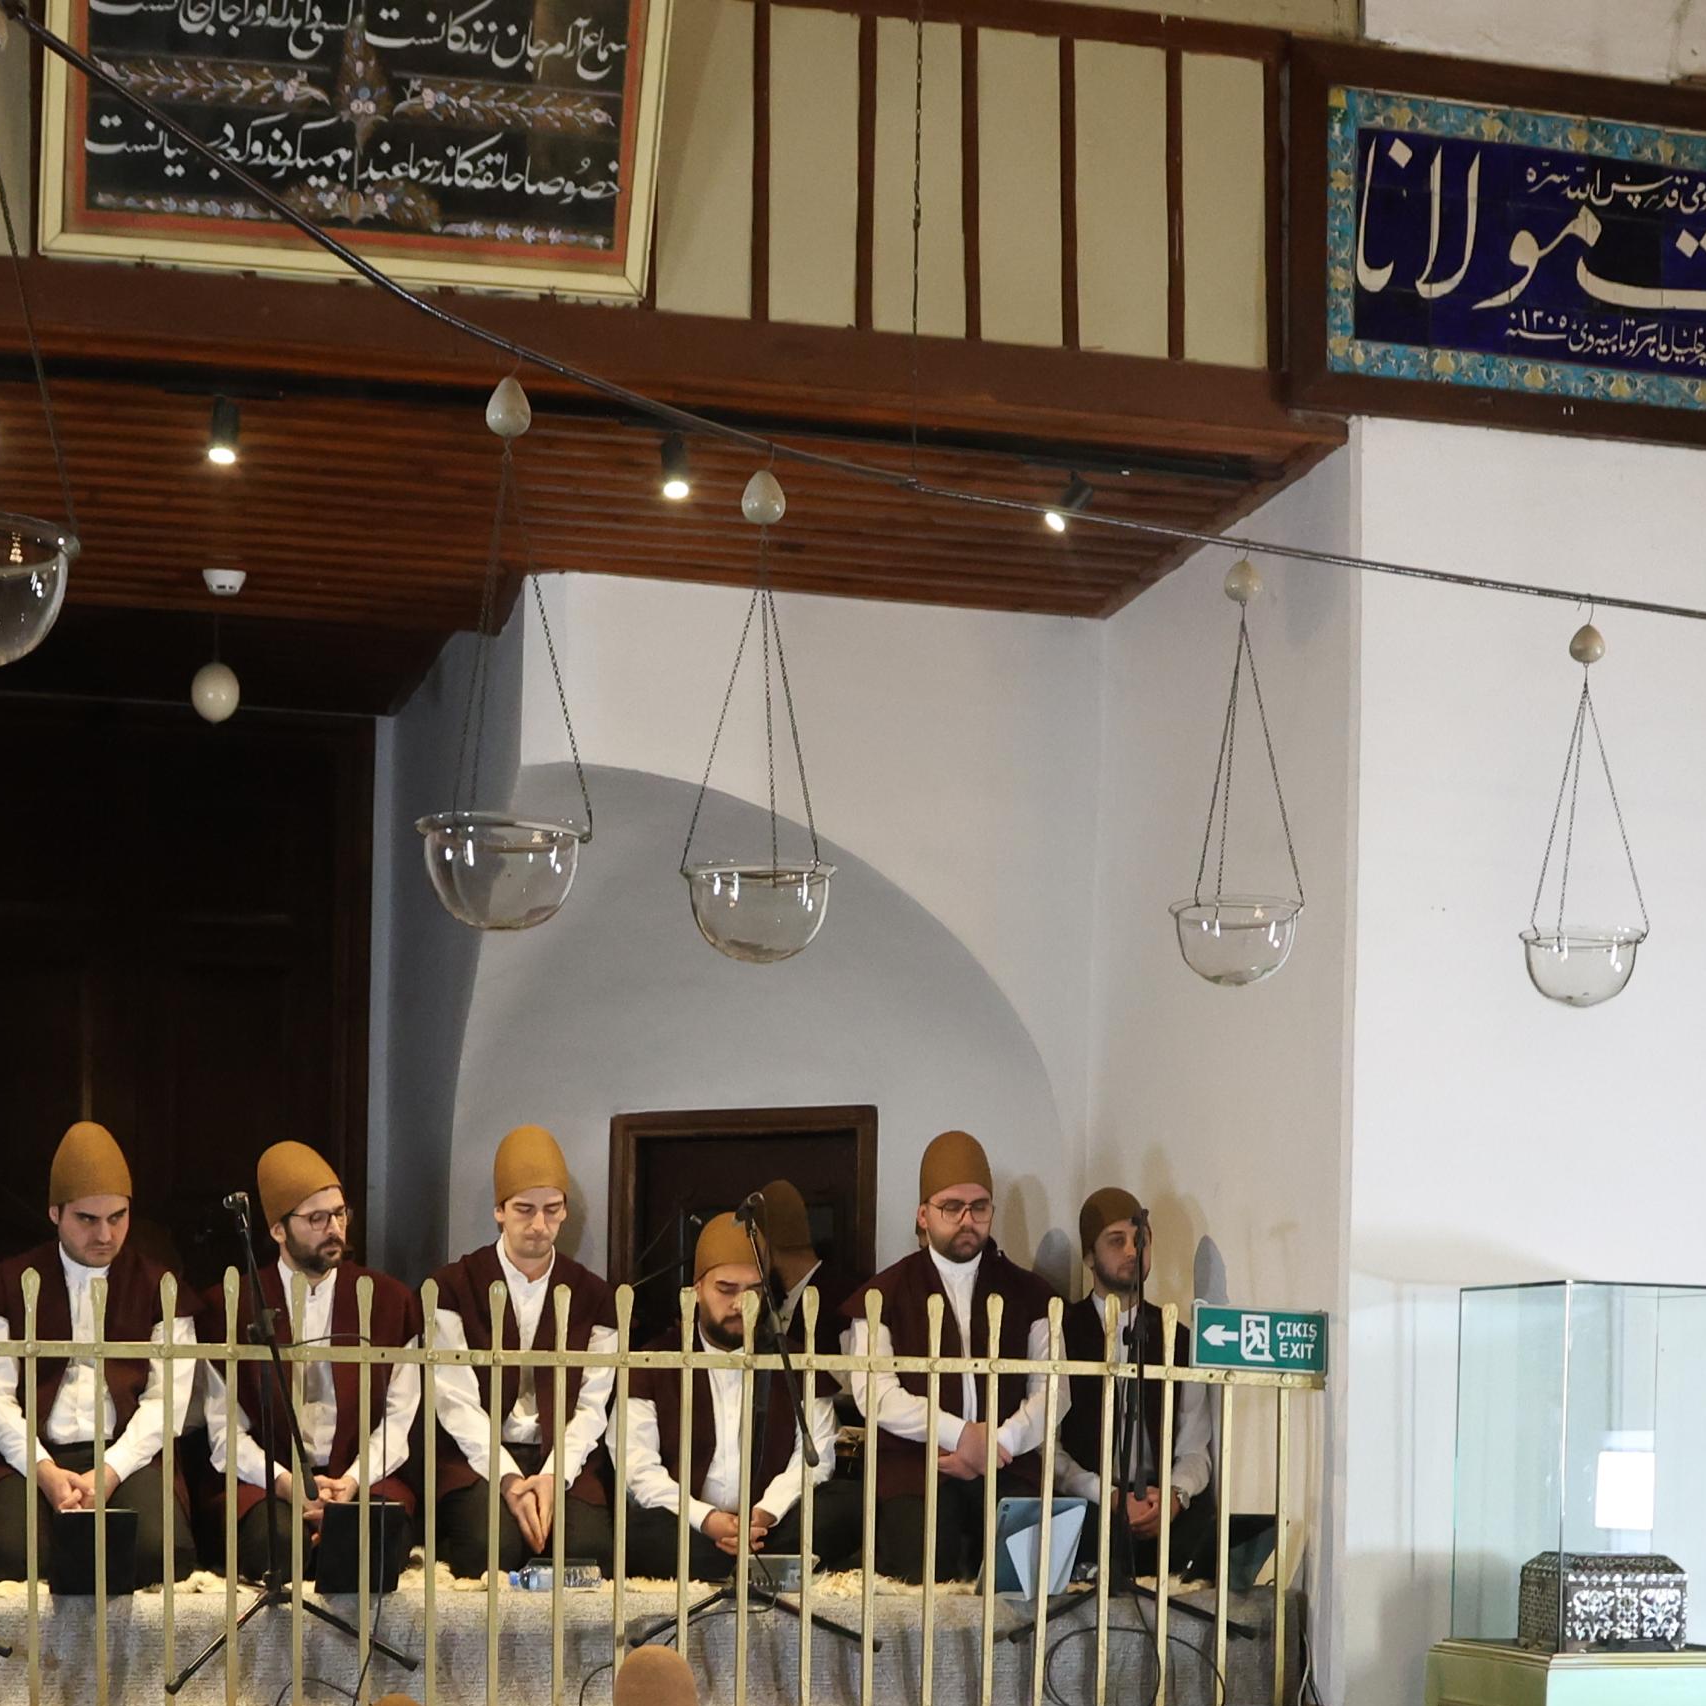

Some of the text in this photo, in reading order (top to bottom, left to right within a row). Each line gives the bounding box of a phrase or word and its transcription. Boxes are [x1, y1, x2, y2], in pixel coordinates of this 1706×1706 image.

[1355, 138, 1602, 310] مولانا
[1276, 1321, 1318, 1342] ÇIKIŞ
[1279, 1342, 1315, 1359] EXIT
